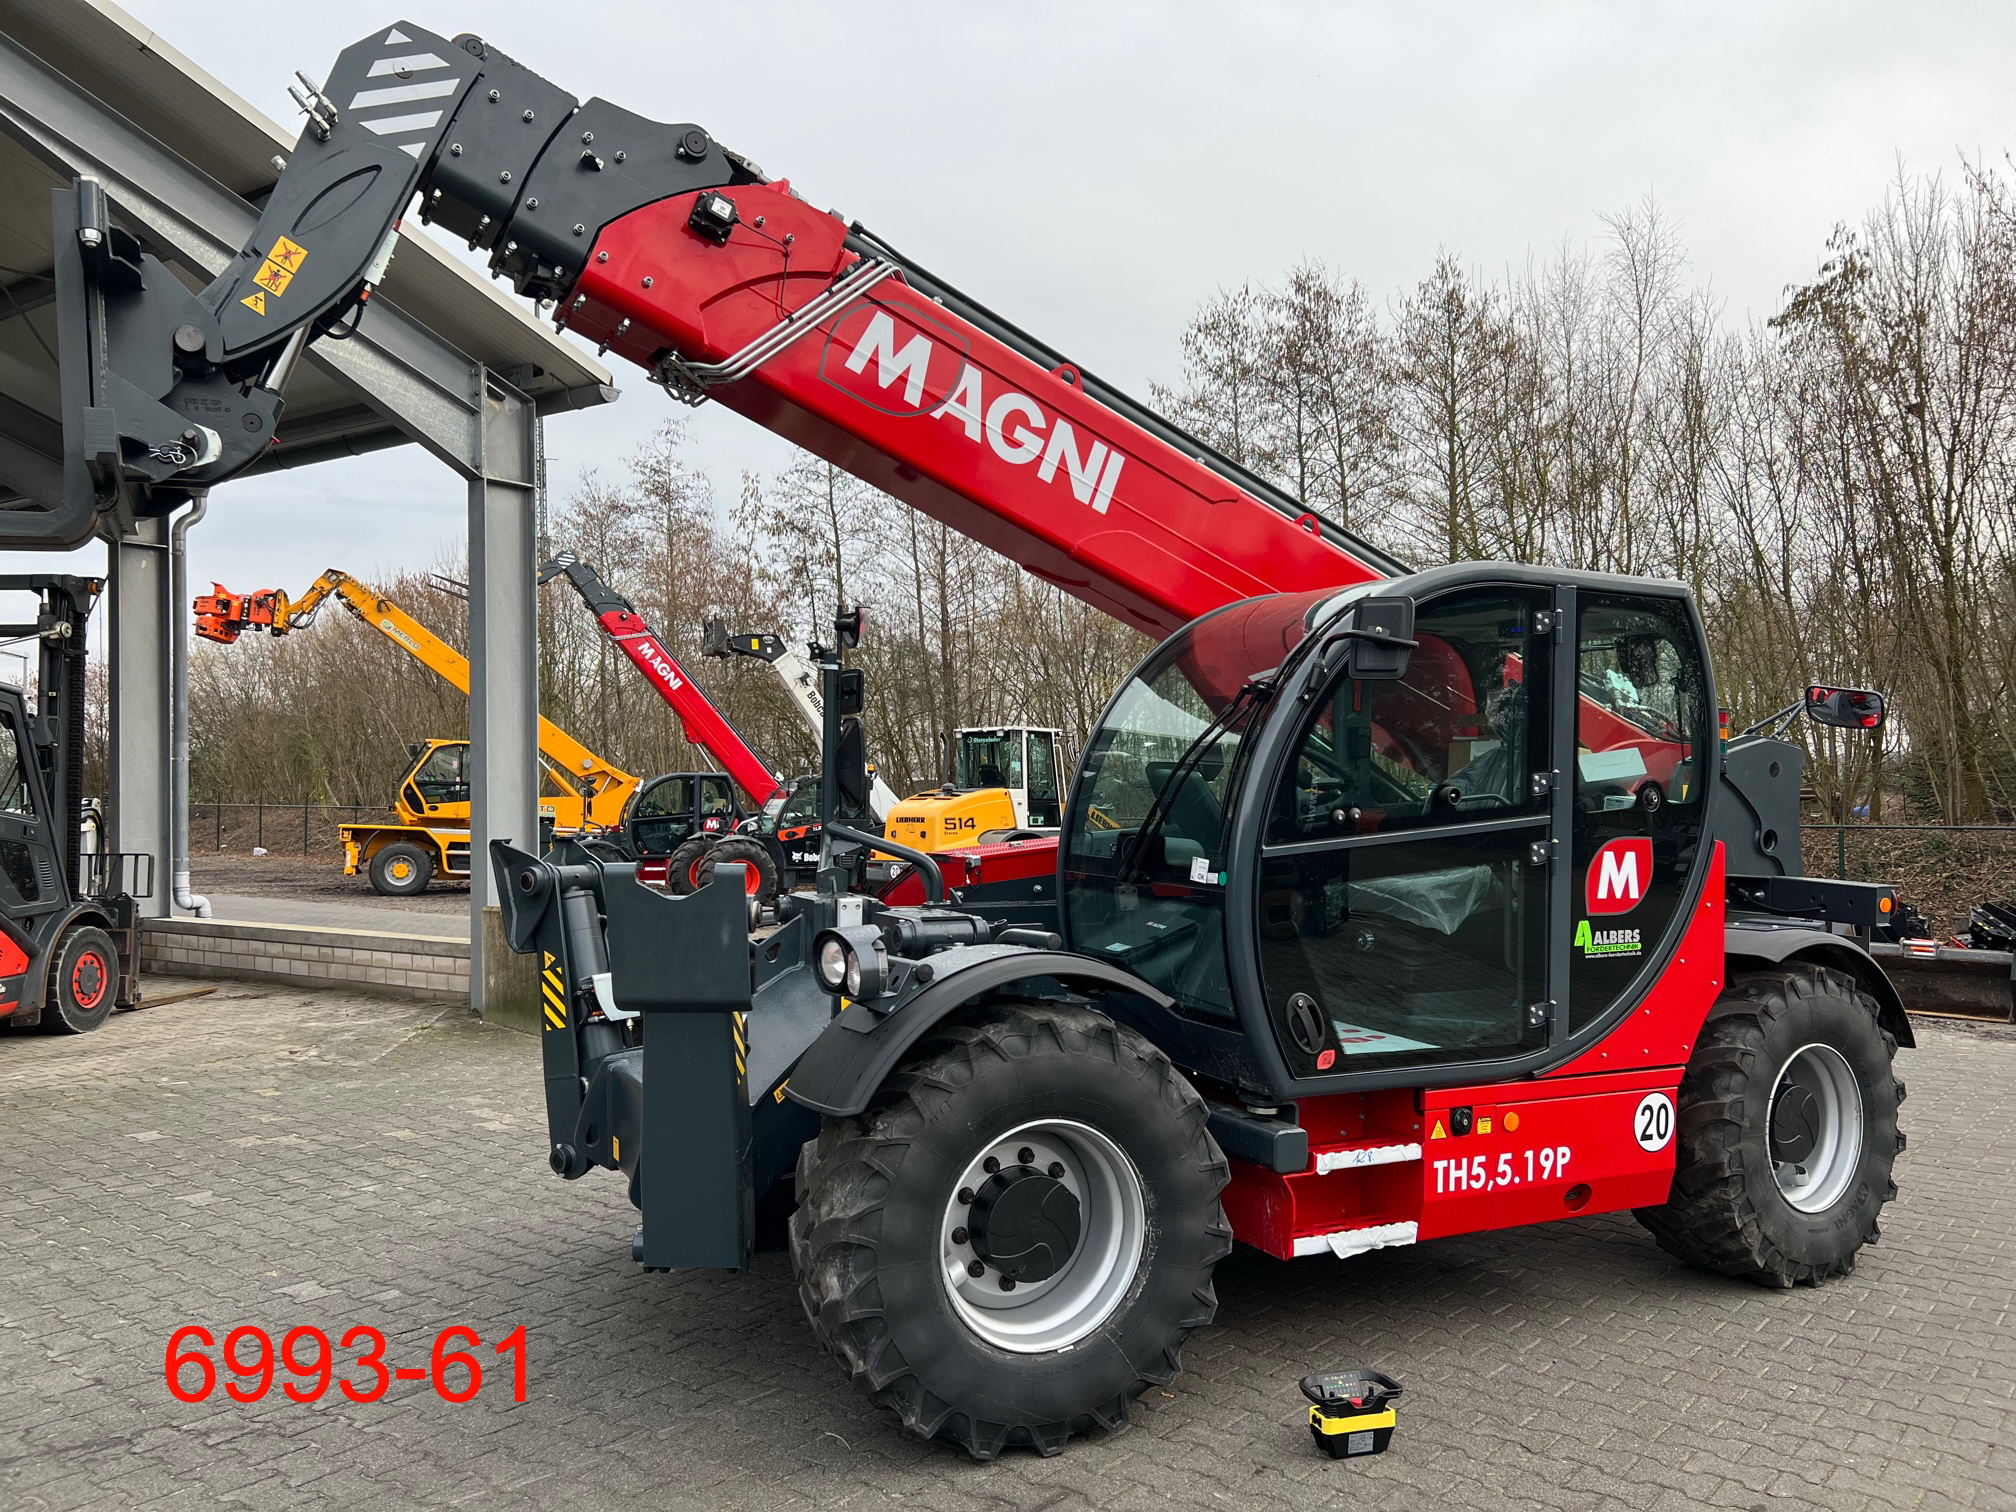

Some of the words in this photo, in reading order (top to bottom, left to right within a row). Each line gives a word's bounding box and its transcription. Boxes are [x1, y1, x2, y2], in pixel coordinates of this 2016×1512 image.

[844, 310, 1126, 515] MAGNI
[637, 642, 683, 691] MAGNI
[706, 819, 717, 829] M
[944, 817, 976, 830] 514
[1597, 850, 1640, 899] M
[1593, 928, 1641, 945] ALBERS
[1640, 1102, 1670, 1142] 20
[1433, 1146, 1571, 1194] TH5,5.19P
